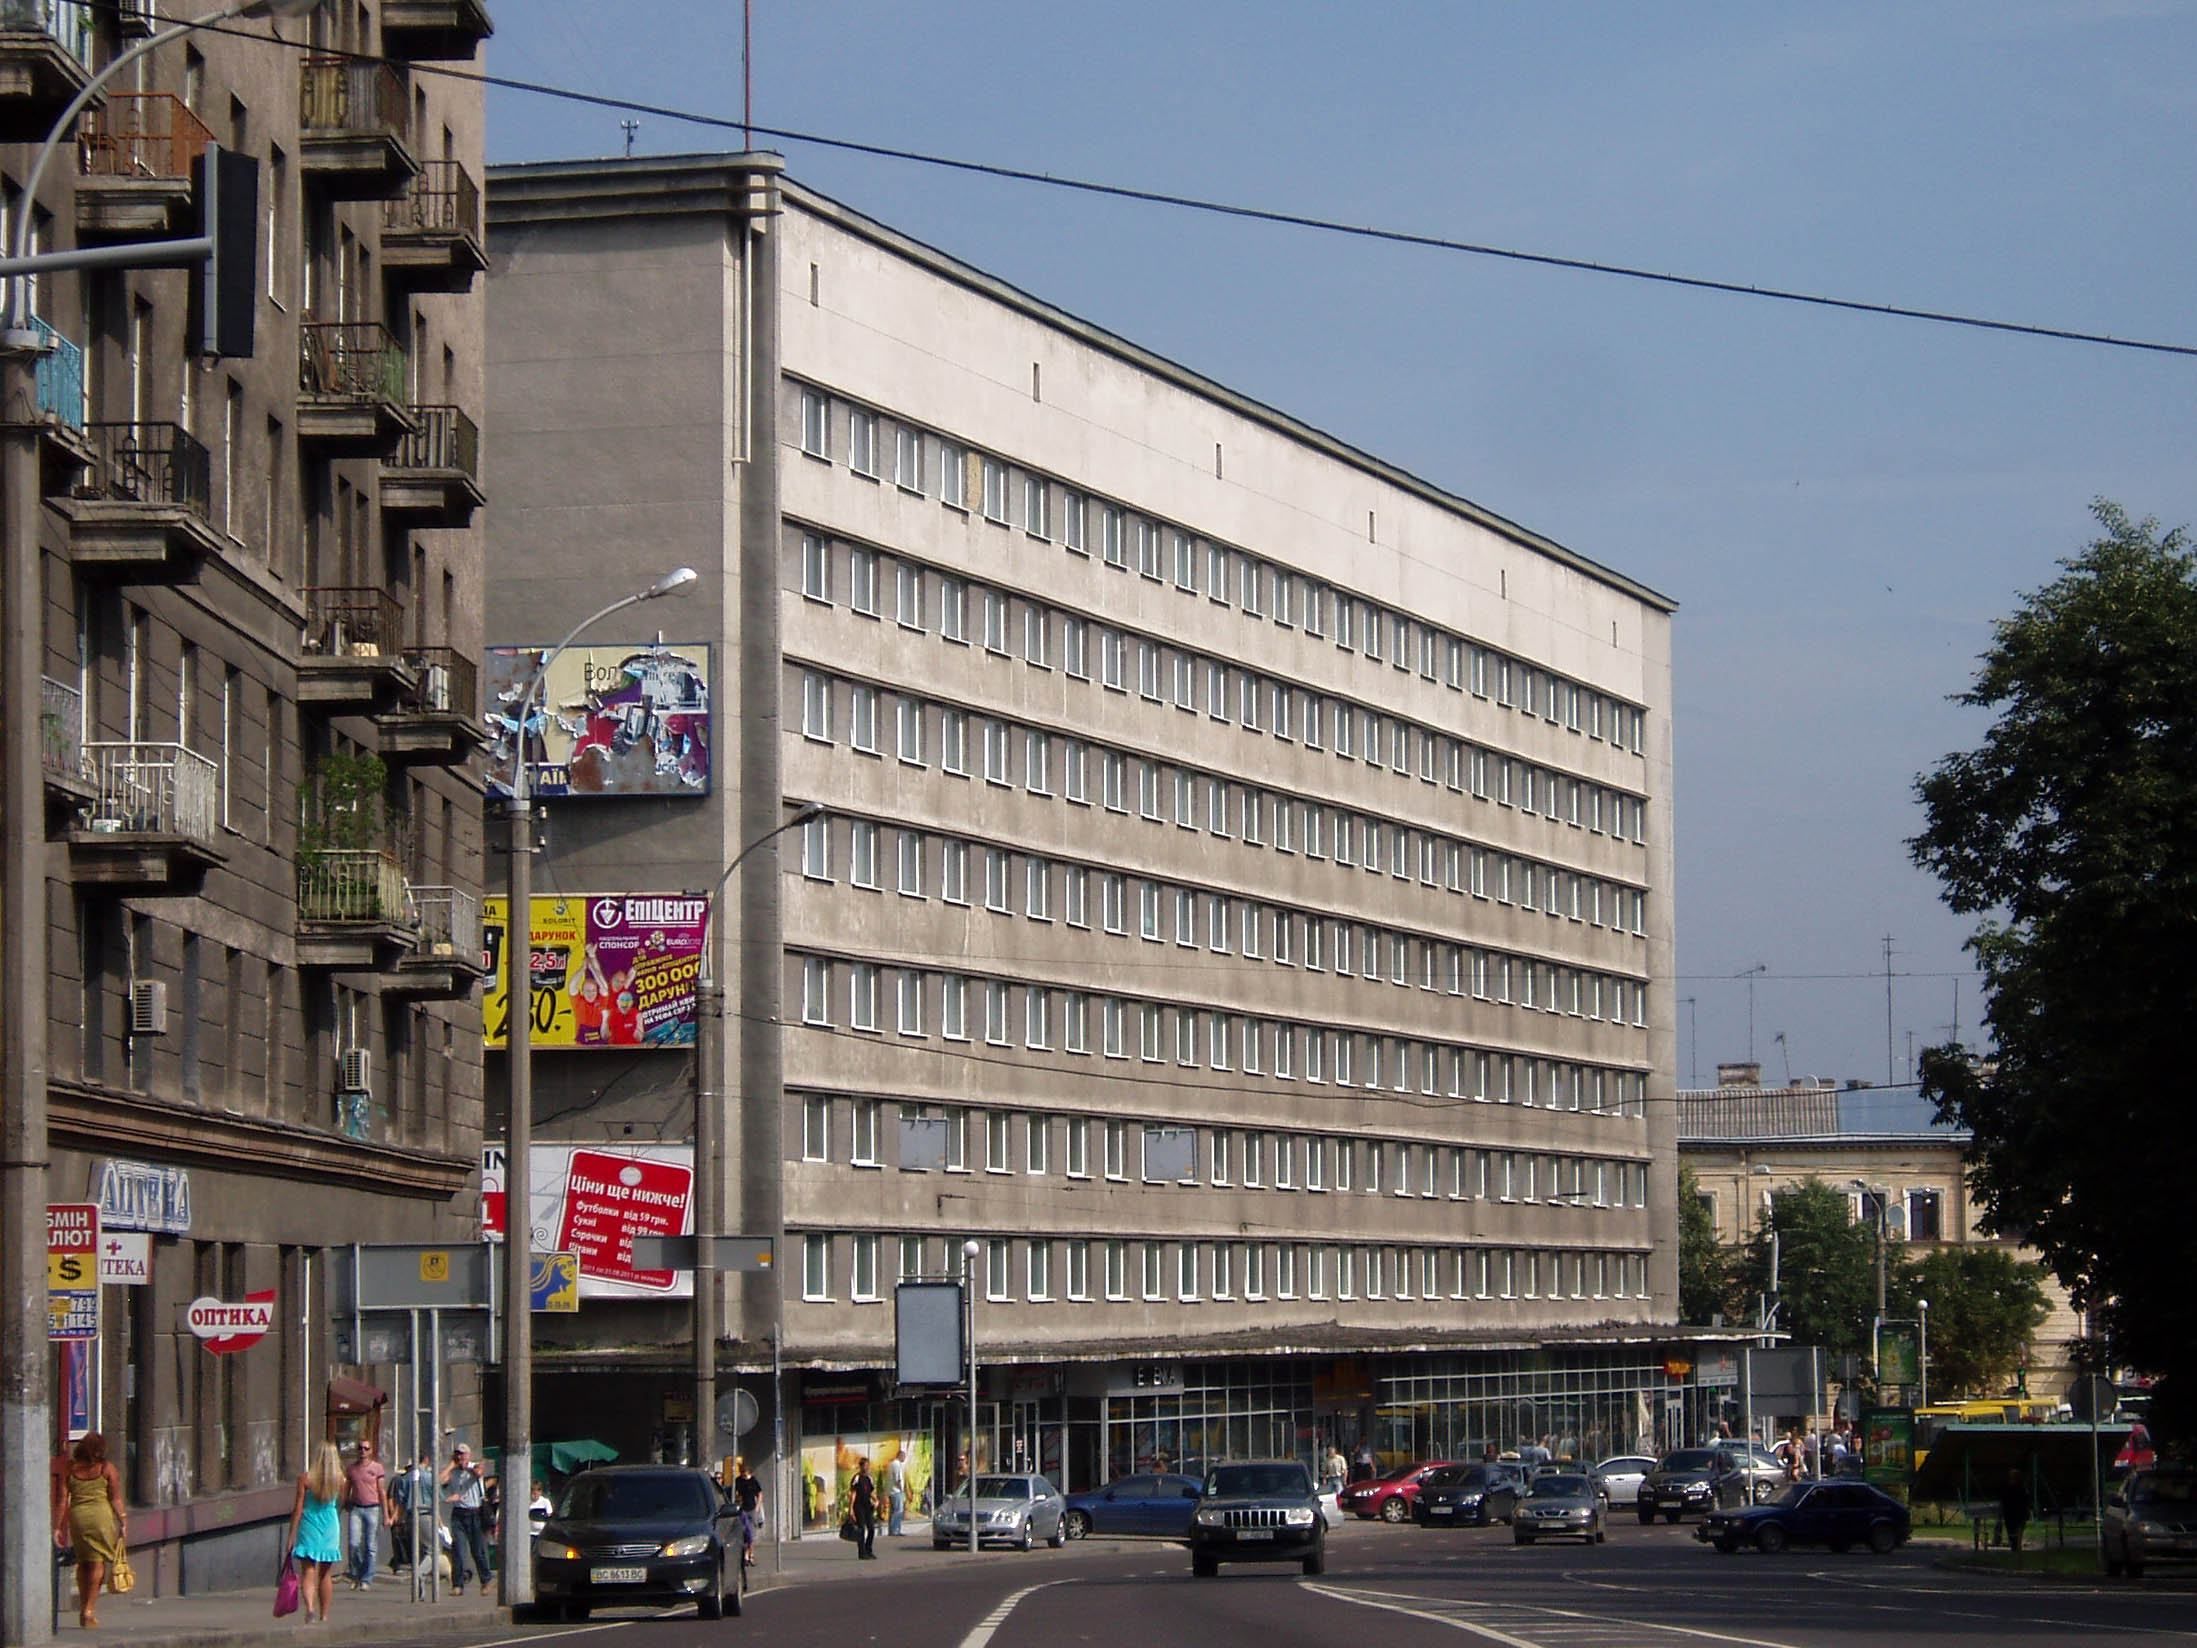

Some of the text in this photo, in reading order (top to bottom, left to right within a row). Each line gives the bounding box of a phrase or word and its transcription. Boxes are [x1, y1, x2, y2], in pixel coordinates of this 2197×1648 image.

[625, 898, 705, 923] ЕПІЦЕНТР
[599, 941, 640, 950] СПОНСОР
[635, 971, 669, 994] 300
[570, 1174, 686, 1209] Ціни ще нижче!
[573, 1214, 597, 1227] Сукні
[621, 1223, 637, 1235] від
[575, 1200, 669, 1227] Футболки від 59 грн.
[570, 1228, 608, 1244] Сорочки
[191, 1308, 270, 1326] ОПТИКА
